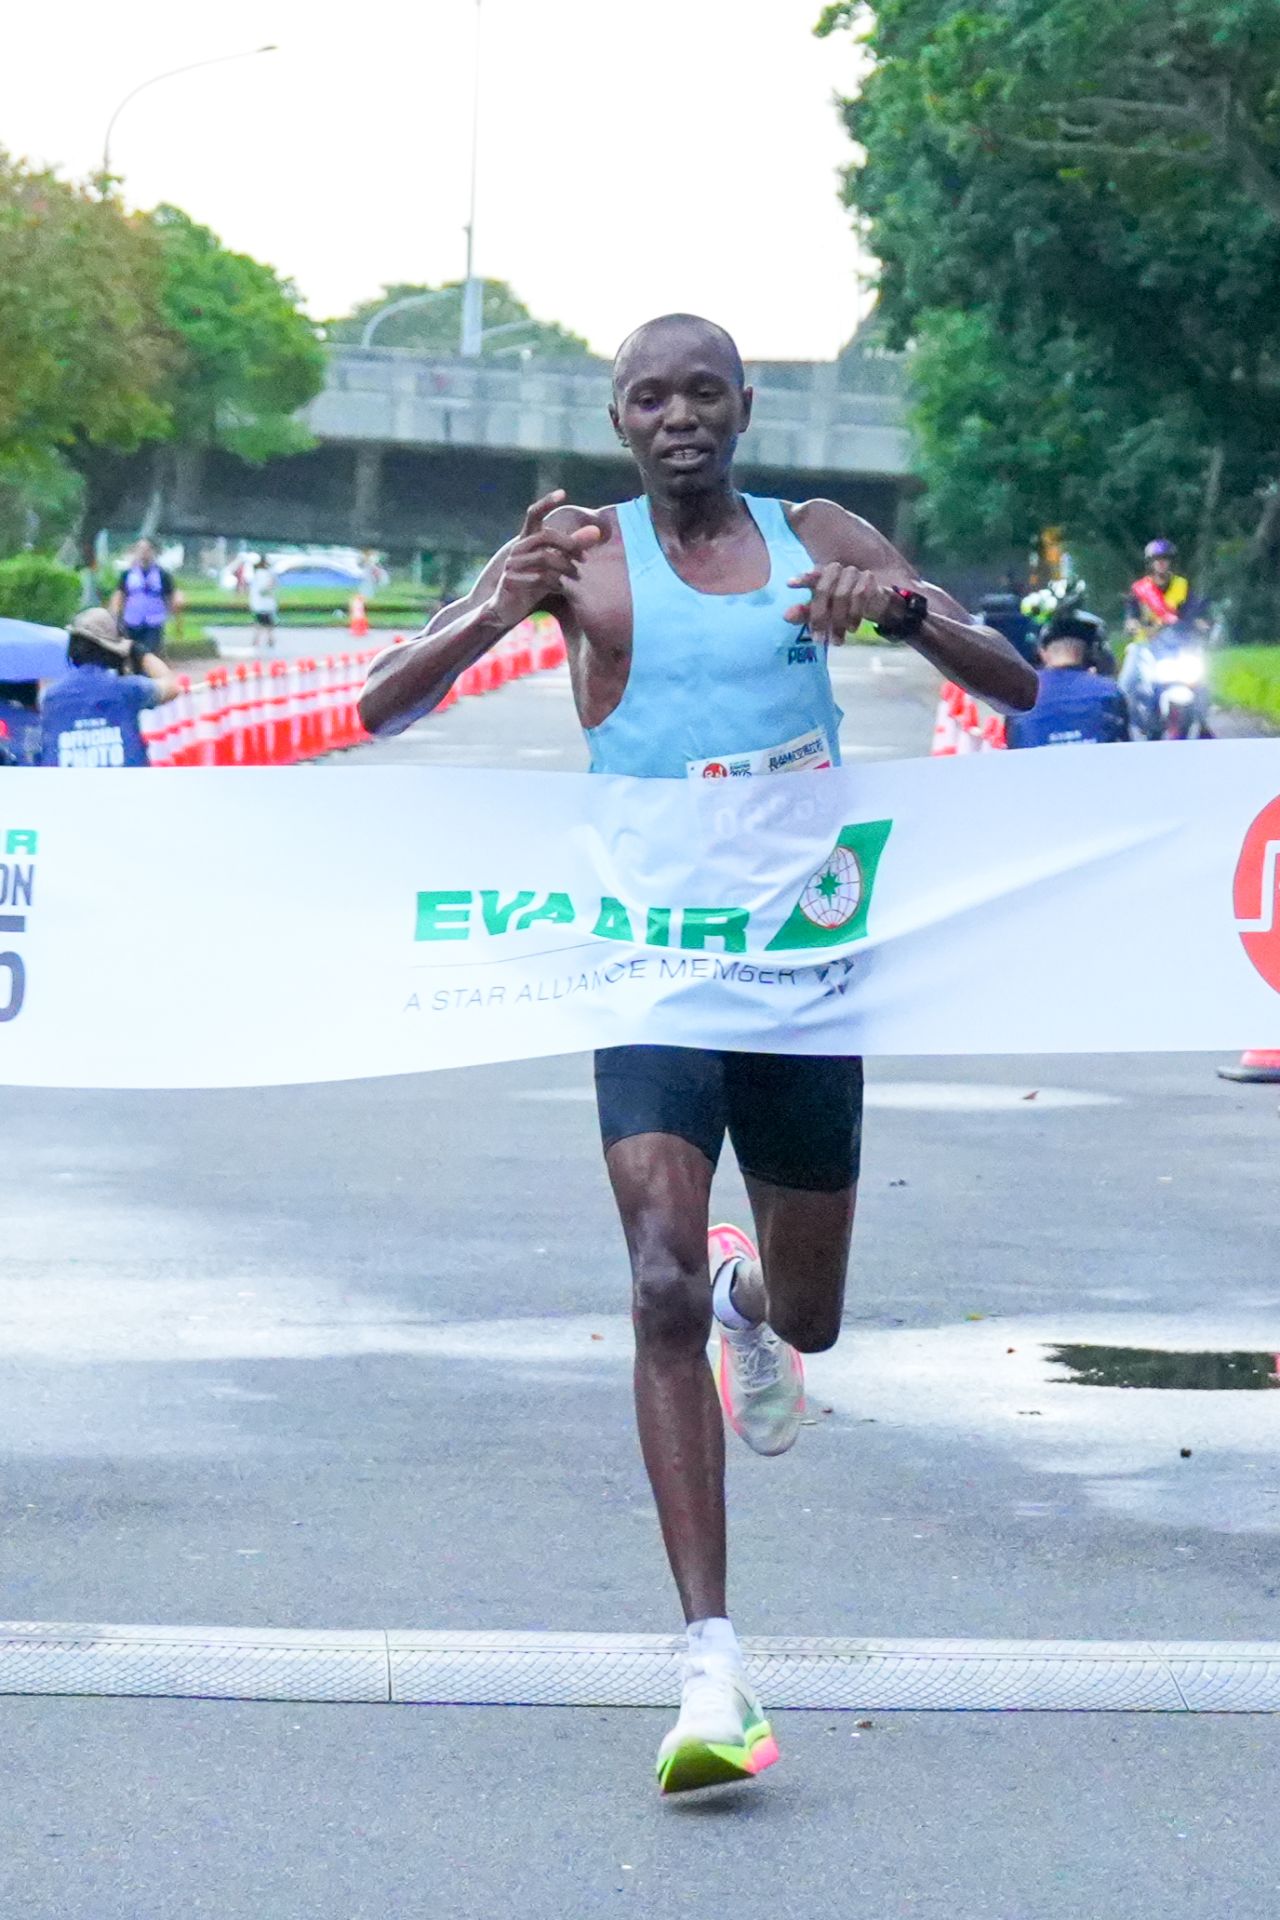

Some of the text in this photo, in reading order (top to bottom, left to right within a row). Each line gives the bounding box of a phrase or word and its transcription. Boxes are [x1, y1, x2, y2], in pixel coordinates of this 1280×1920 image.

[414, 890, 750, 953] EVA AIR
[402, 993, 421, 1012] A
[431, 986, 506, 1011] STAR
[514, 958, 648, 1004] ALLIANCE
